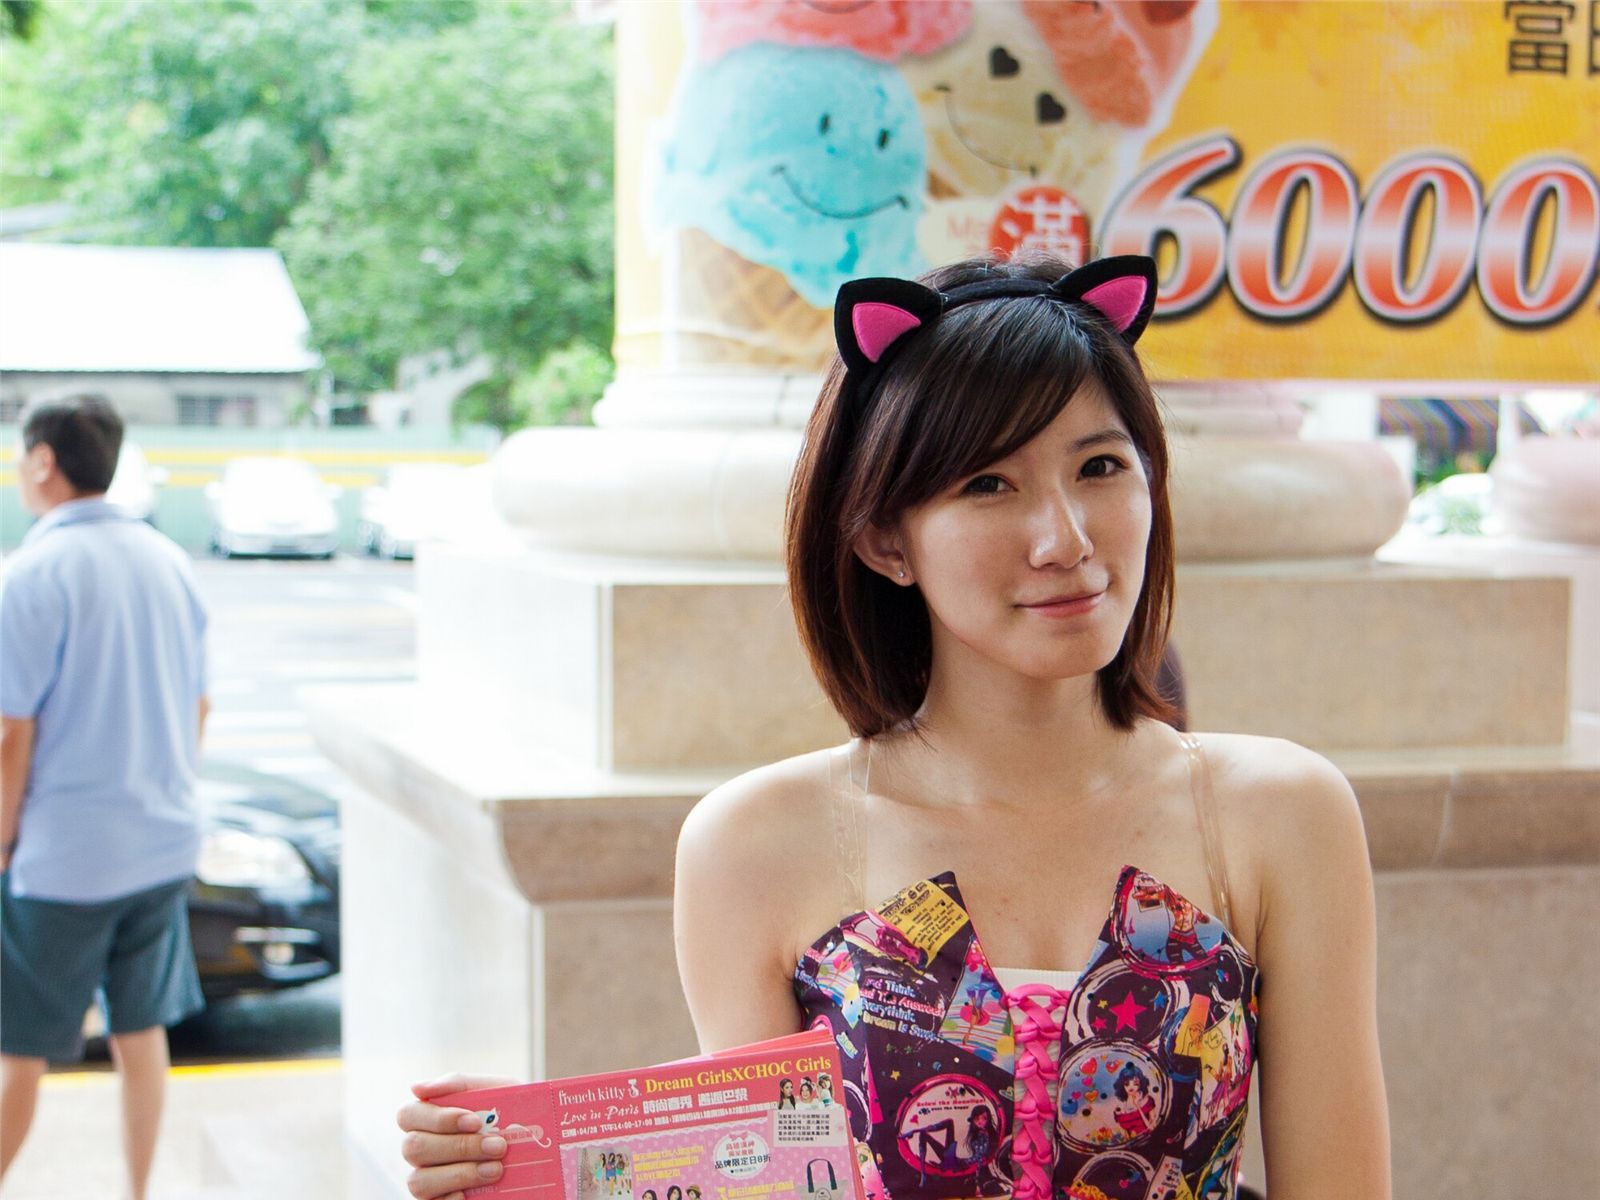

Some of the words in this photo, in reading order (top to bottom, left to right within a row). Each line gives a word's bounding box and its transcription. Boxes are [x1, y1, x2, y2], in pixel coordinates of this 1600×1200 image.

[1099, 135, 1600, 330] 6000
[597, 1086, 625, 1101] kitty
[645, 1077, 694, 1094] Dream
[697, 1060, 793, 1086] GirlsXCHOC
[795, 1056, 832, 1073] Girls
[560, 1111, 587, 1126] Love
[590, 1109, 602, 1121] in
[604, 1104, 640, 1120] Paris
